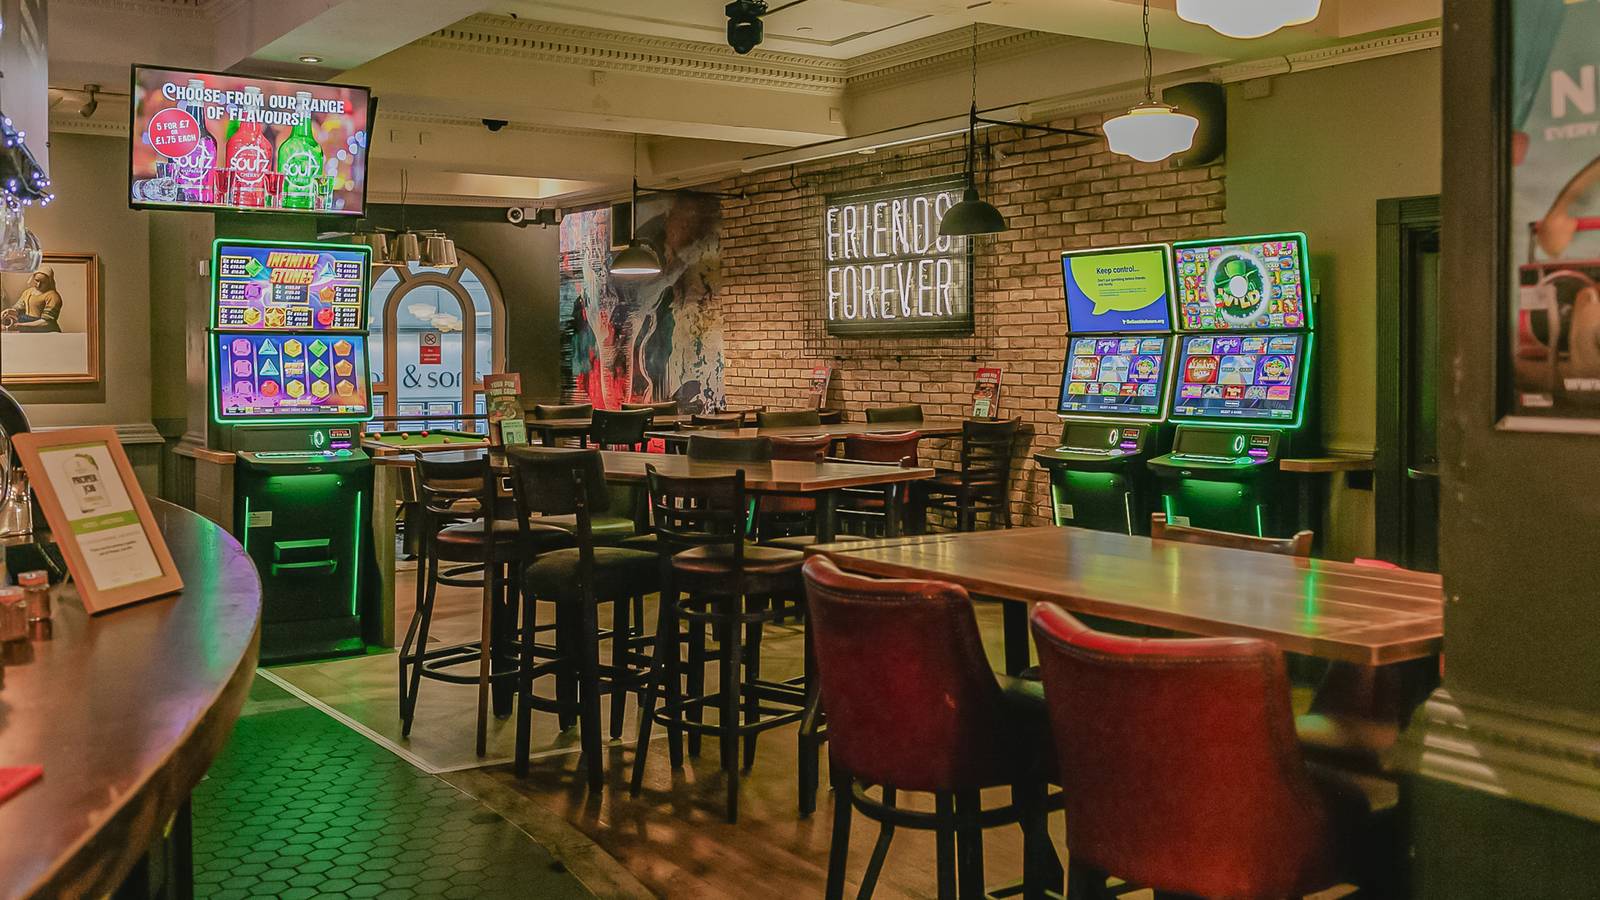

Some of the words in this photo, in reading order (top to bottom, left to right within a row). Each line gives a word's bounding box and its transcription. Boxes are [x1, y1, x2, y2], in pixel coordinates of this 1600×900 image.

[161, 82, 220, 102] CHOOSE
[226, 90, 264, 107] FROM
[269, 94, 296, 110] OUR
[300, 99, 345, 114] RANGE
[1551, 64, 1600, 119] N
[156, 122, 162, 131] 5
[163, 122, 178, 130] FOR
[179, 119, 190, 129] £7
[206, 105, 225, 120] OF
[229, 107, 304, 126] FLAVOURS!
[155, 135, 176, 145] £1.75
[178, 133, 197, 143] EACH
[827, 191, 951, 261] FRIENDS
[267, 252, 319, 268] INFINITY
[269, 268, 315, 284] STONES
[1096, 267, 1112, 275] Keep
[828, 258, 953, 321] FOREVER
[1222, 289, 1260, 309] WILD
[402, 363, 422, 389] &
